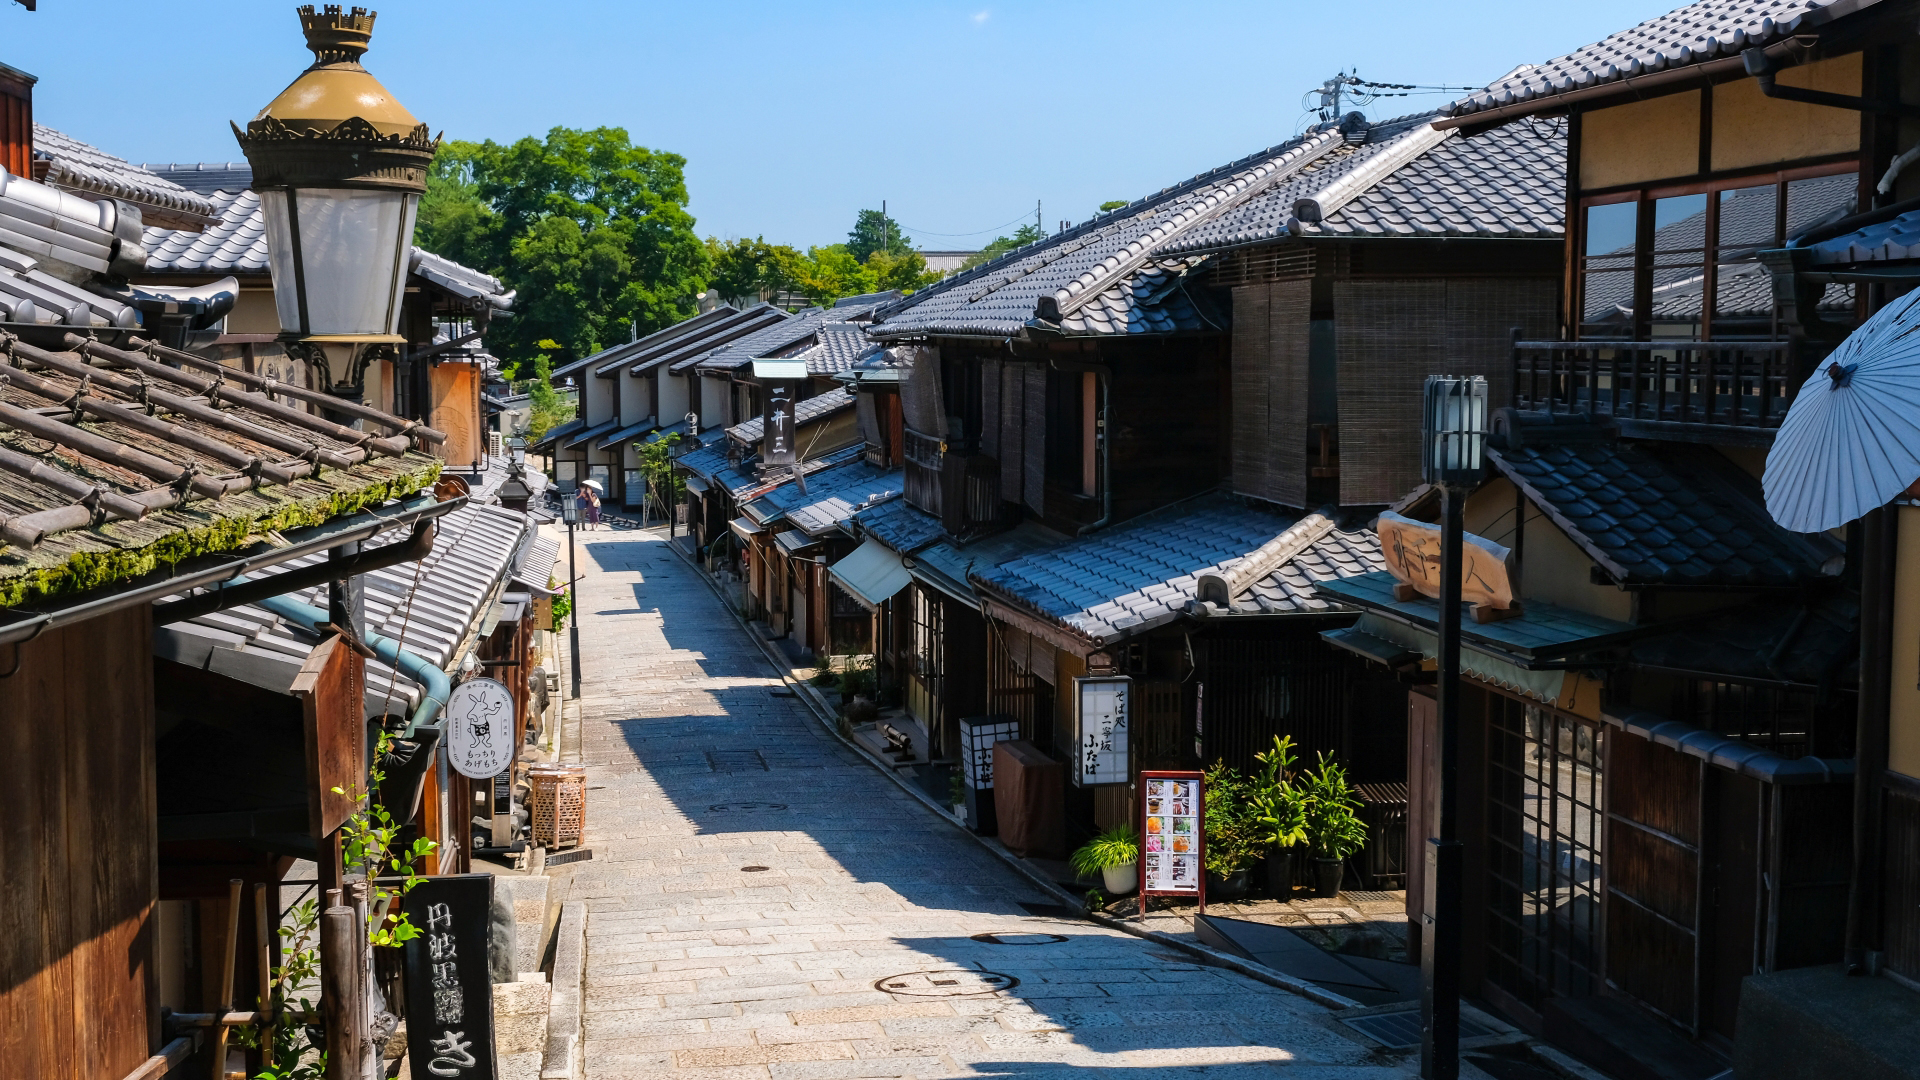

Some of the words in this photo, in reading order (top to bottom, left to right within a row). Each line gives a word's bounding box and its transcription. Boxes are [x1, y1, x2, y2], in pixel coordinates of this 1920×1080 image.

[770, 387, 791, 453] 二井三
[1114, 690, 1126, 729] そば処
[465, 759, 498, 768] あげもち
[467, 750, 496, 759] もっちり
[1084, 734, 1100, 775] ふたば
